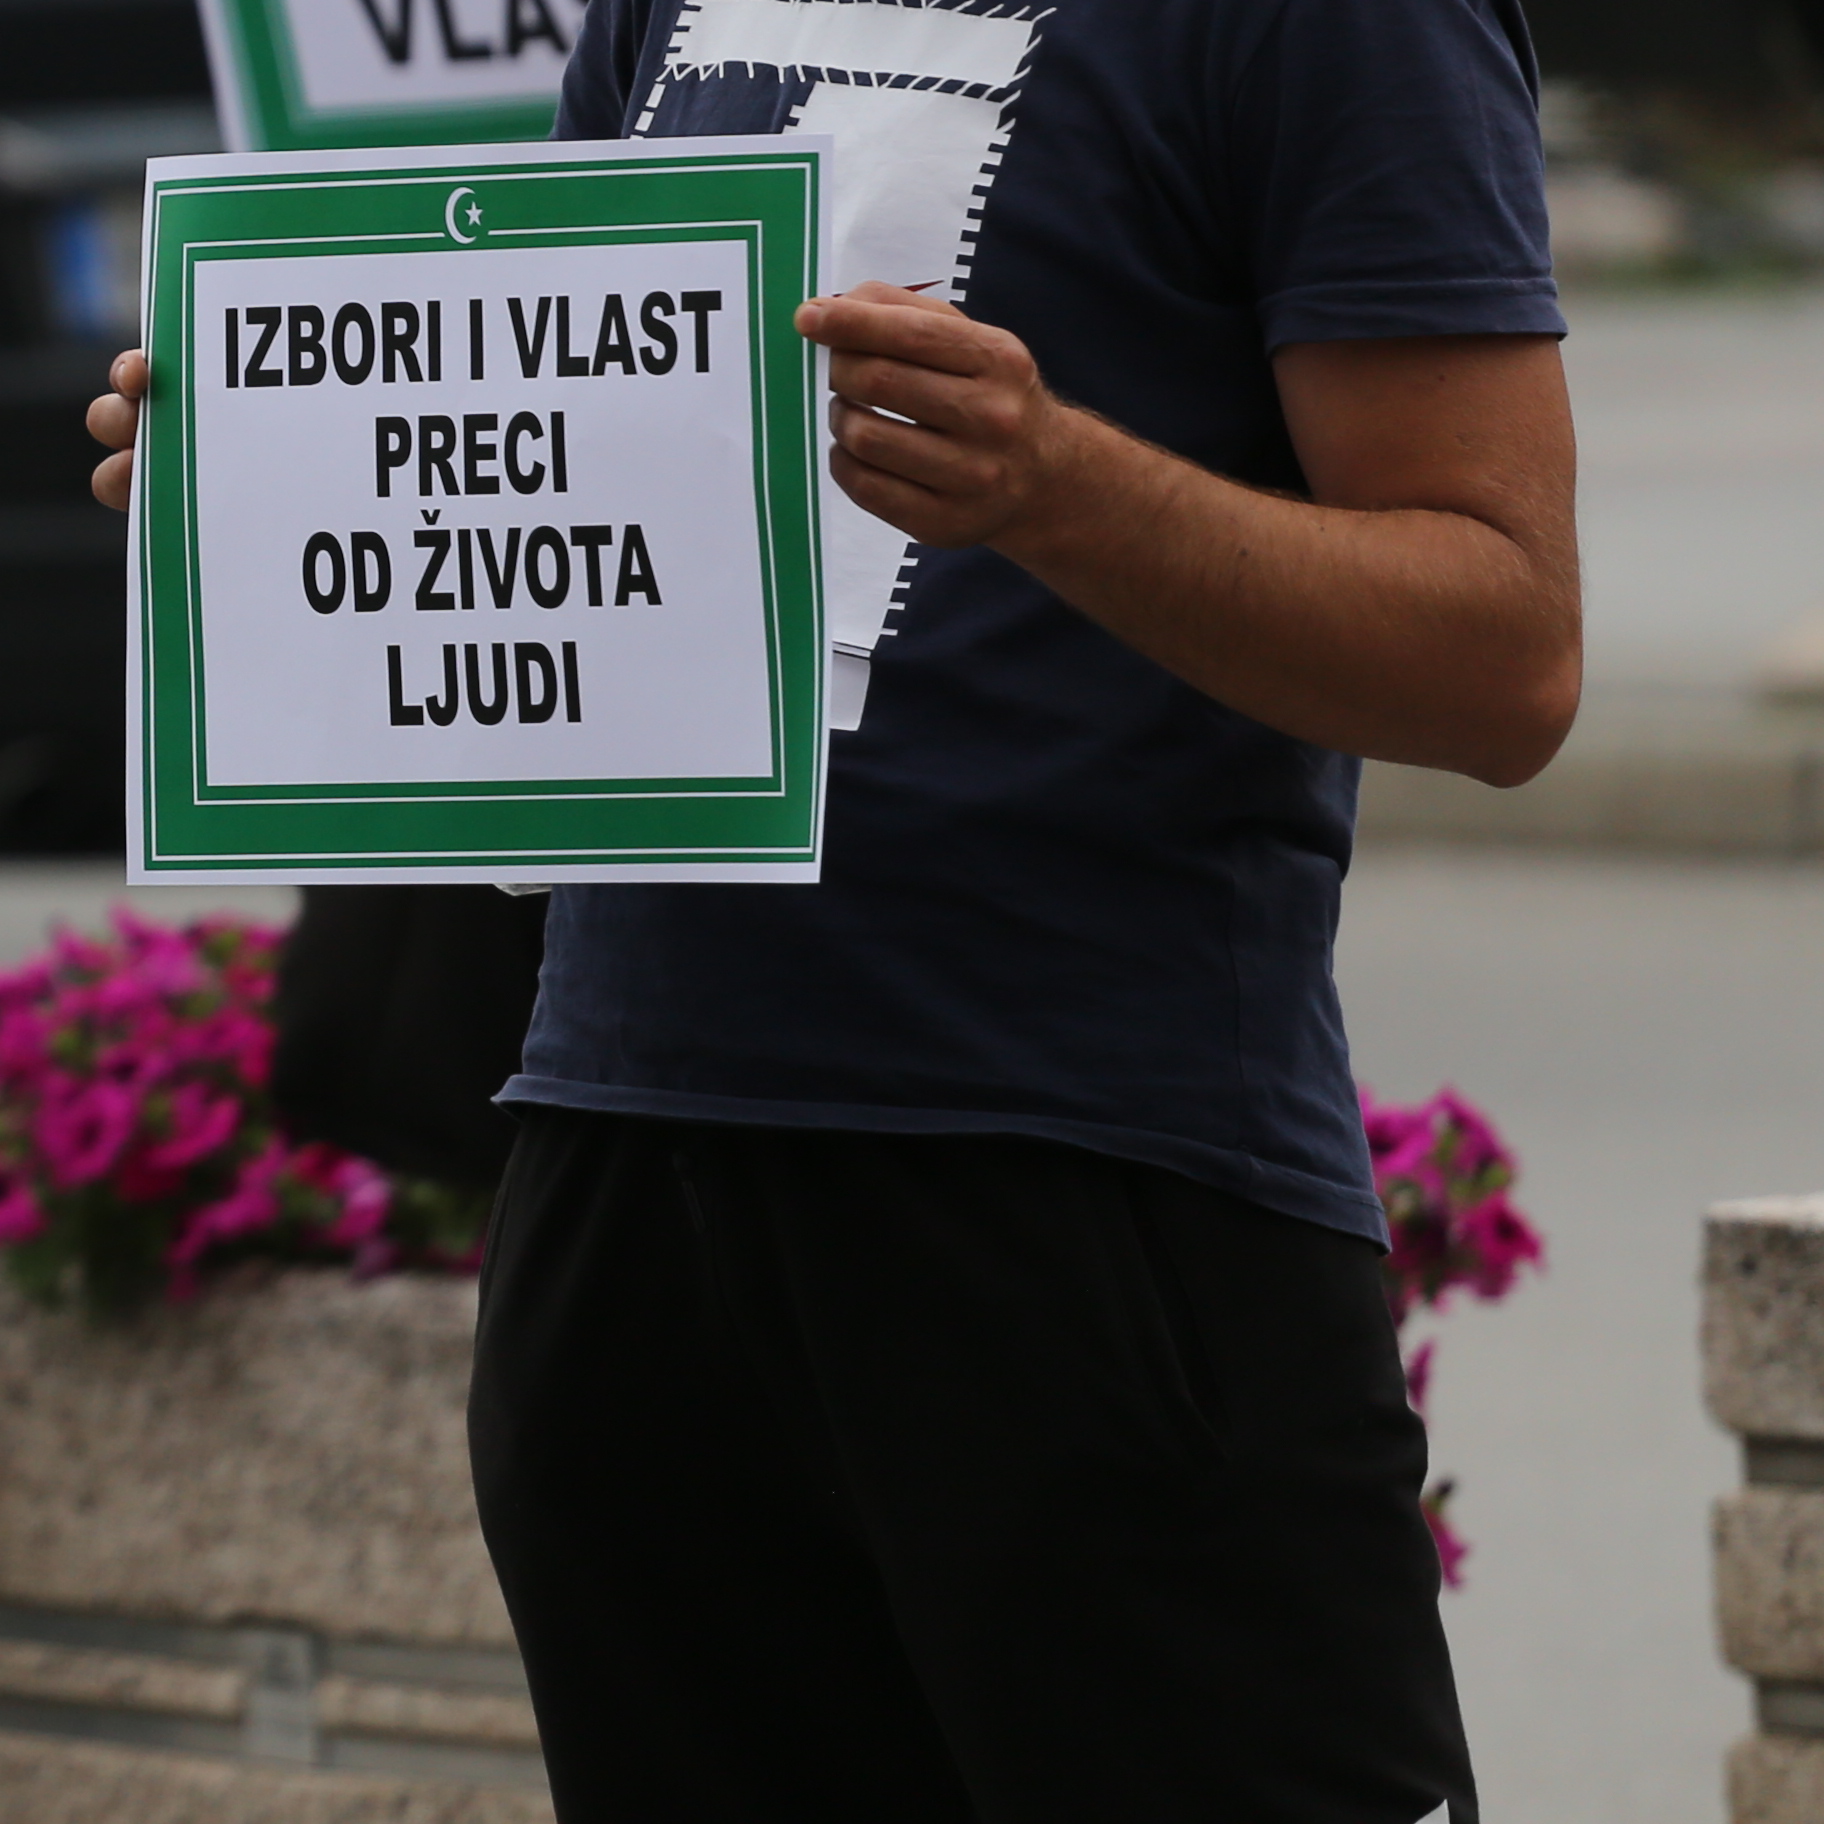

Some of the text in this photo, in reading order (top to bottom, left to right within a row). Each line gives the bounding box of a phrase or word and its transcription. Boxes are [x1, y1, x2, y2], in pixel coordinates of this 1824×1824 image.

[226, 291, 721, 388] IZBORI I VLAST
[376, 411, 567, 497] PRECI
[303, 509, 662, 614] OD ŽIVOTA
[387, 641, 581, 726] LJUDI
